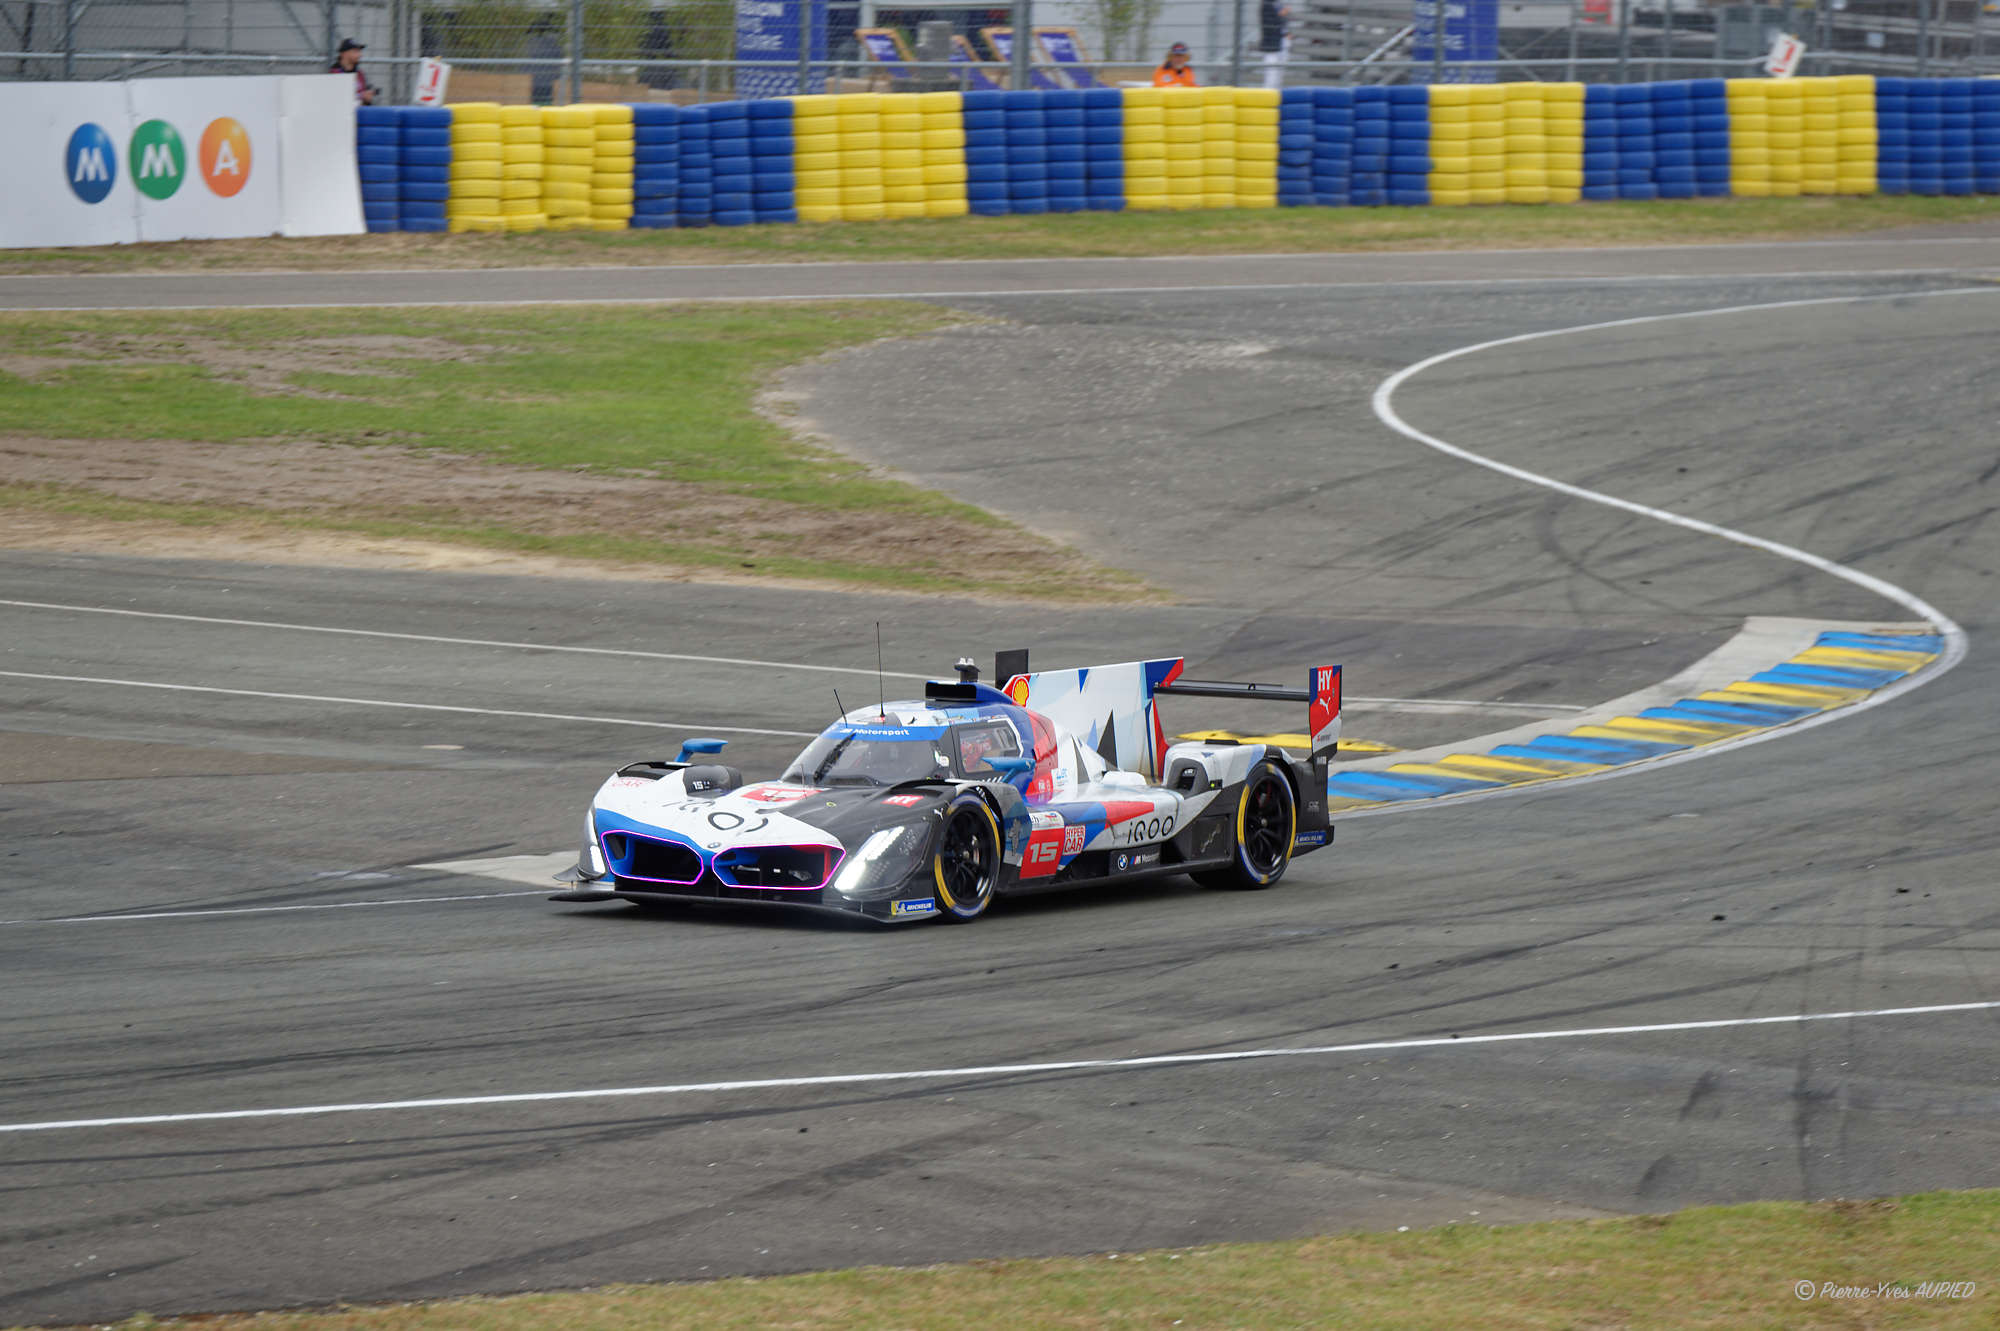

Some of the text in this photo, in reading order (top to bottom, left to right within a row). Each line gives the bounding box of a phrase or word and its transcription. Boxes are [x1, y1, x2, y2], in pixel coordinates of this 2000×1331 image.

[1318, 669, 1332, 692] HY
[853, 728, 910, 736] Motorsport
[1066, 827, 1084, 838] HYPER
[1127, 815, 1174, 844] iQOO
[1030, 841, 1059, 864] 15
[1065, 837, 1083, 853] CAR
[907, 903, 932, 911] MICHELIN
